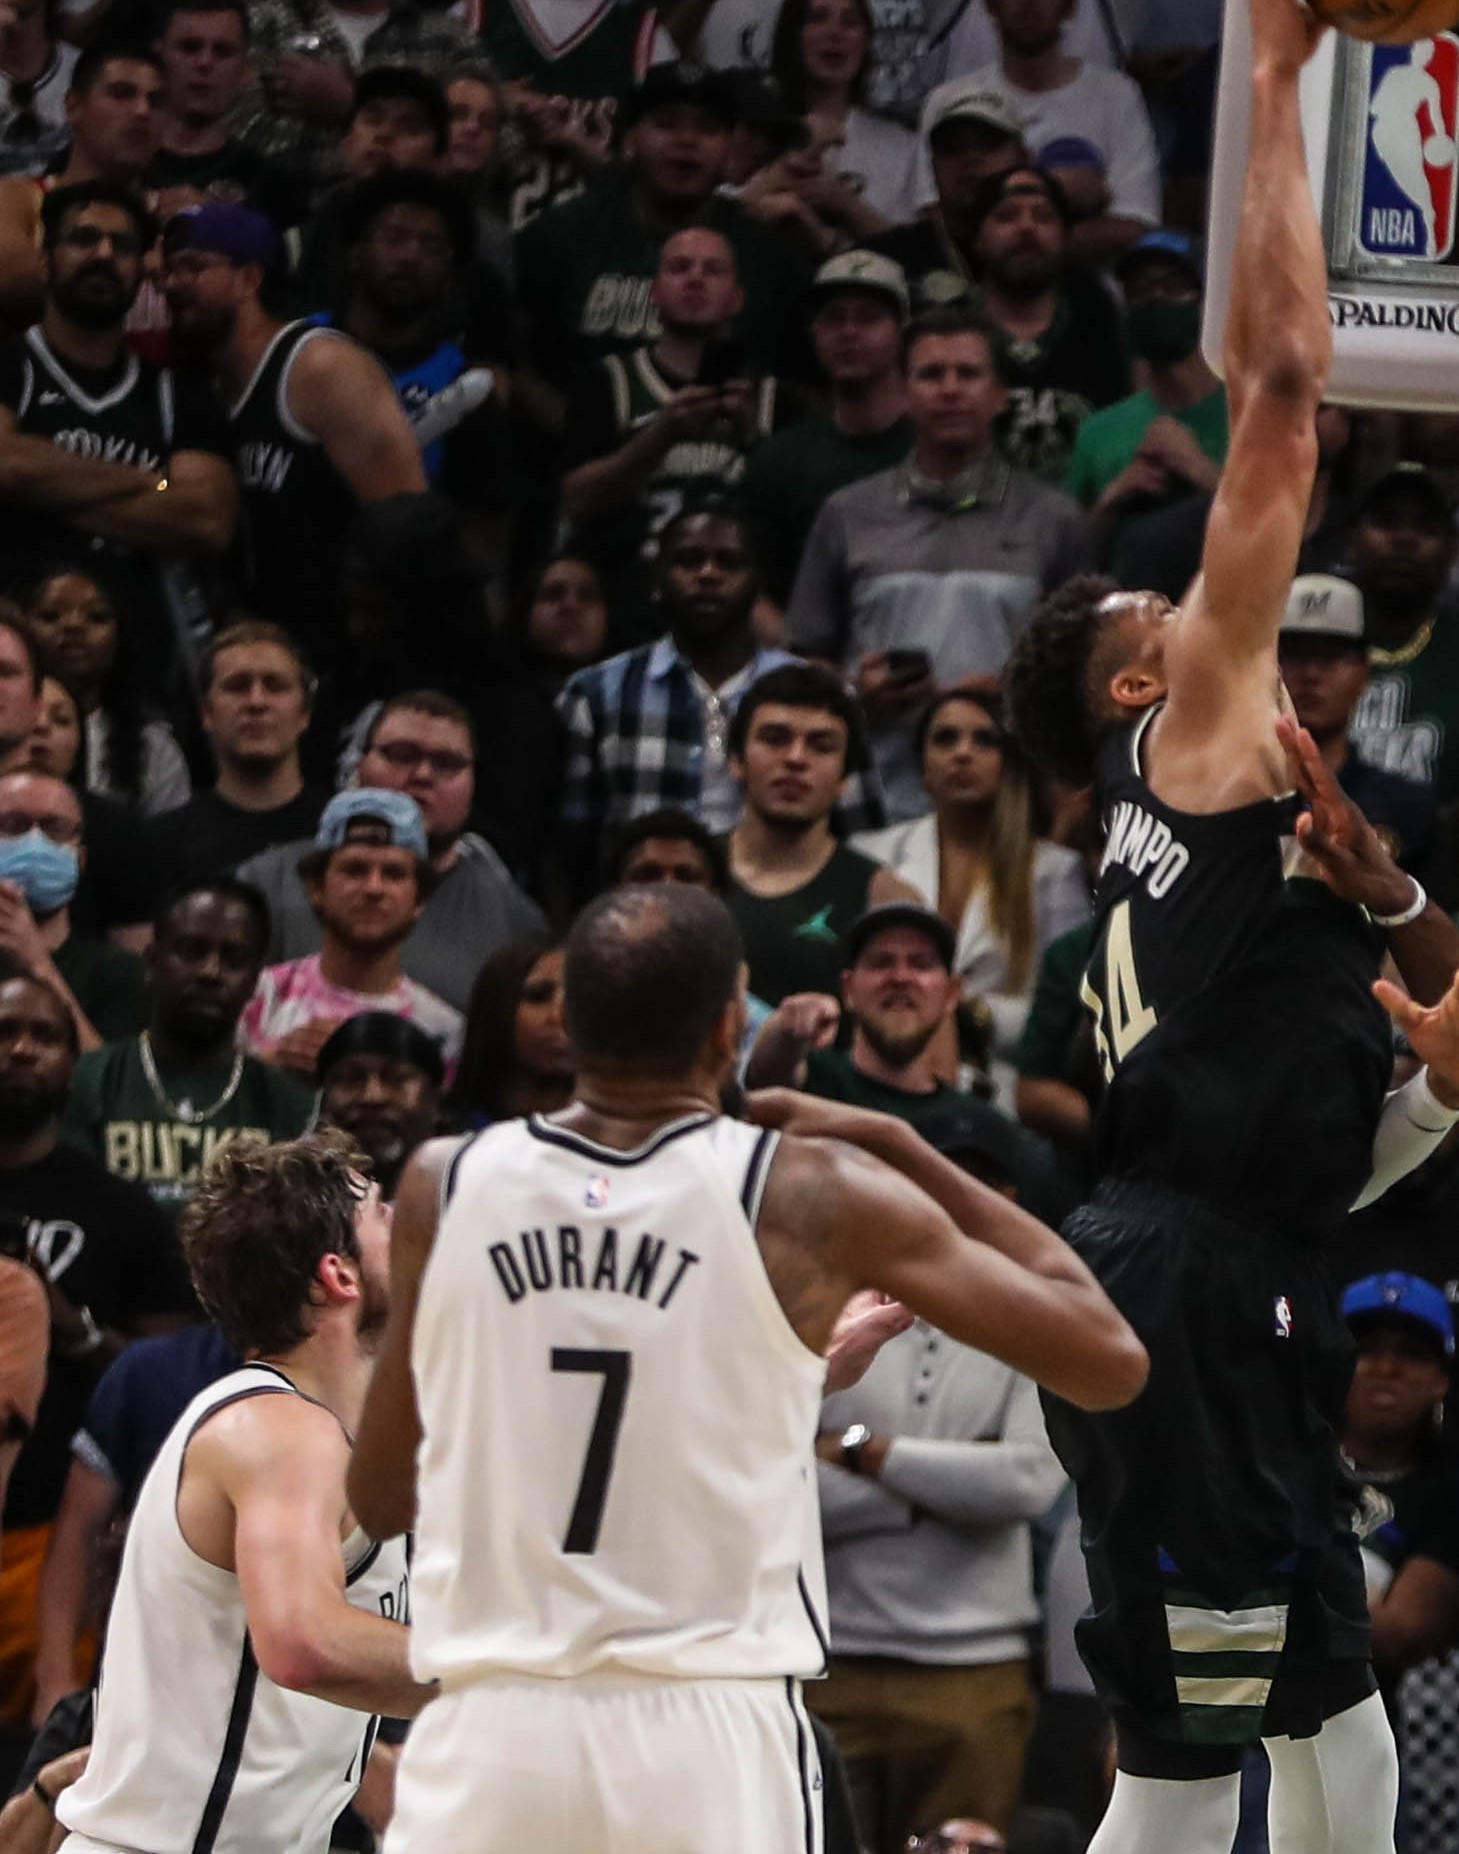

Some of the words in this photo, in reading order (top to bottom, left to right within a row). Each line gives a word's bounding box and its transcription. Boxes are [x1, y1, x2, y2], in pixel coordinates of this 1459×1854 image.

[1370, 206, 1415, 246] NBA
[488, 1226, 701, 1311] DURANT
[549, 1346, 632, 1554] 7
